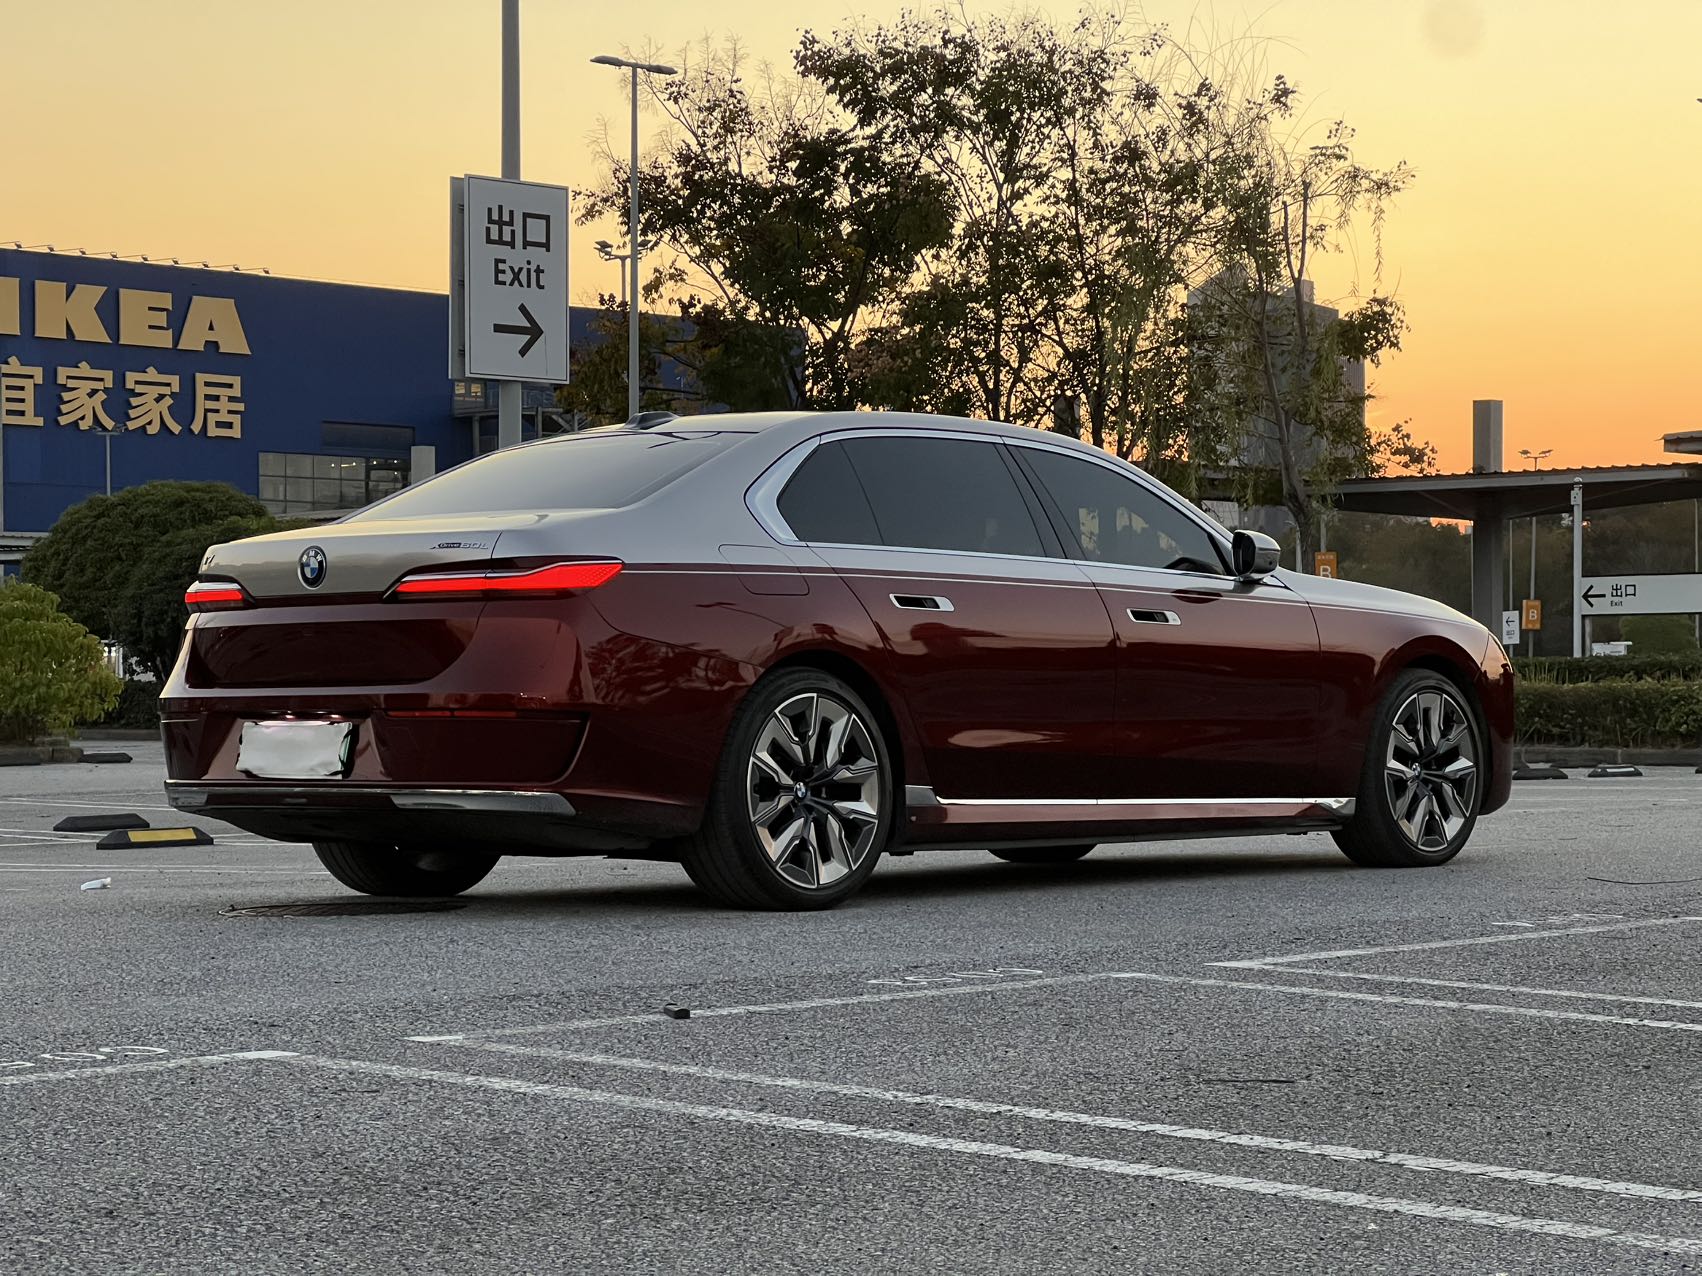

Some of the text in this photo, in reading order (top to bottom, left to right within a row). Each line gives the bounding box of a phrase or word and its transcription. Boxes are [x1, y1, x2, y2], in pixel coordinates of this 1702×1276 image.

[485, 204, 551, 253] 出口
[493, 257, 545, 290] Exit
[0, 276, 252, 355] IKEA
[0, 356, 245, 439] 宜家家居
[1320, 565, 1332, 578] B
[1610, 583, 1637, 598] 出口
[1529, 609, 1538, 620] B
[1610, 599, 1623, 607] Exit
